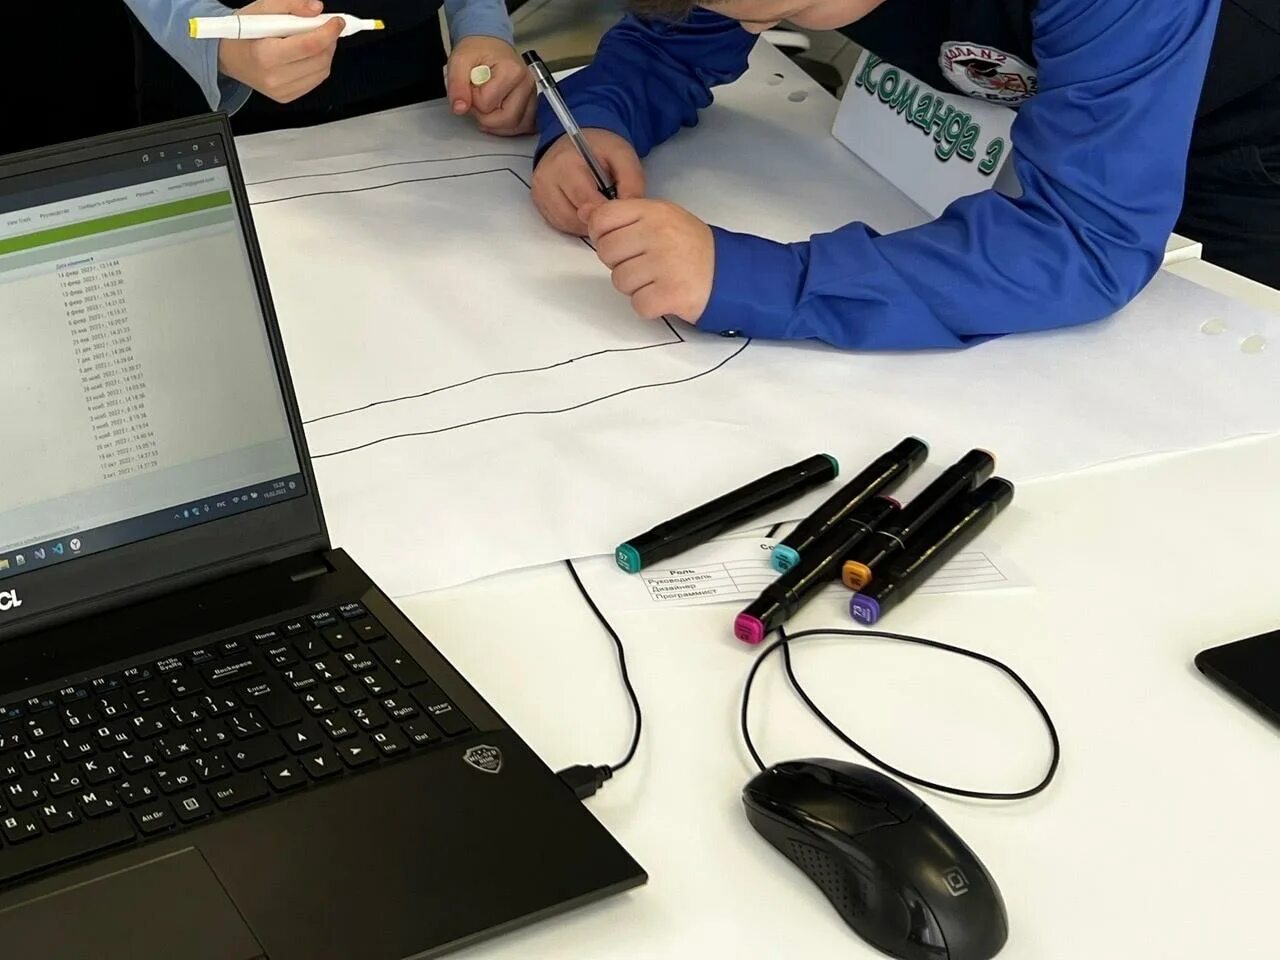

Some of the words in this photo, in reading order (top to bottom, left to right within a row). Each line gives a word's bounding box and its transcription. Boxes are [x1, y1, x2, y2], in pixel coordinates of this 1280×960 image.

[855, 53, 981, 163] Команда
[977, 136, 1004, 176] 3
[214, 660, 253, 675] Backspace
[217, 789, 233, 797] Ctrl
